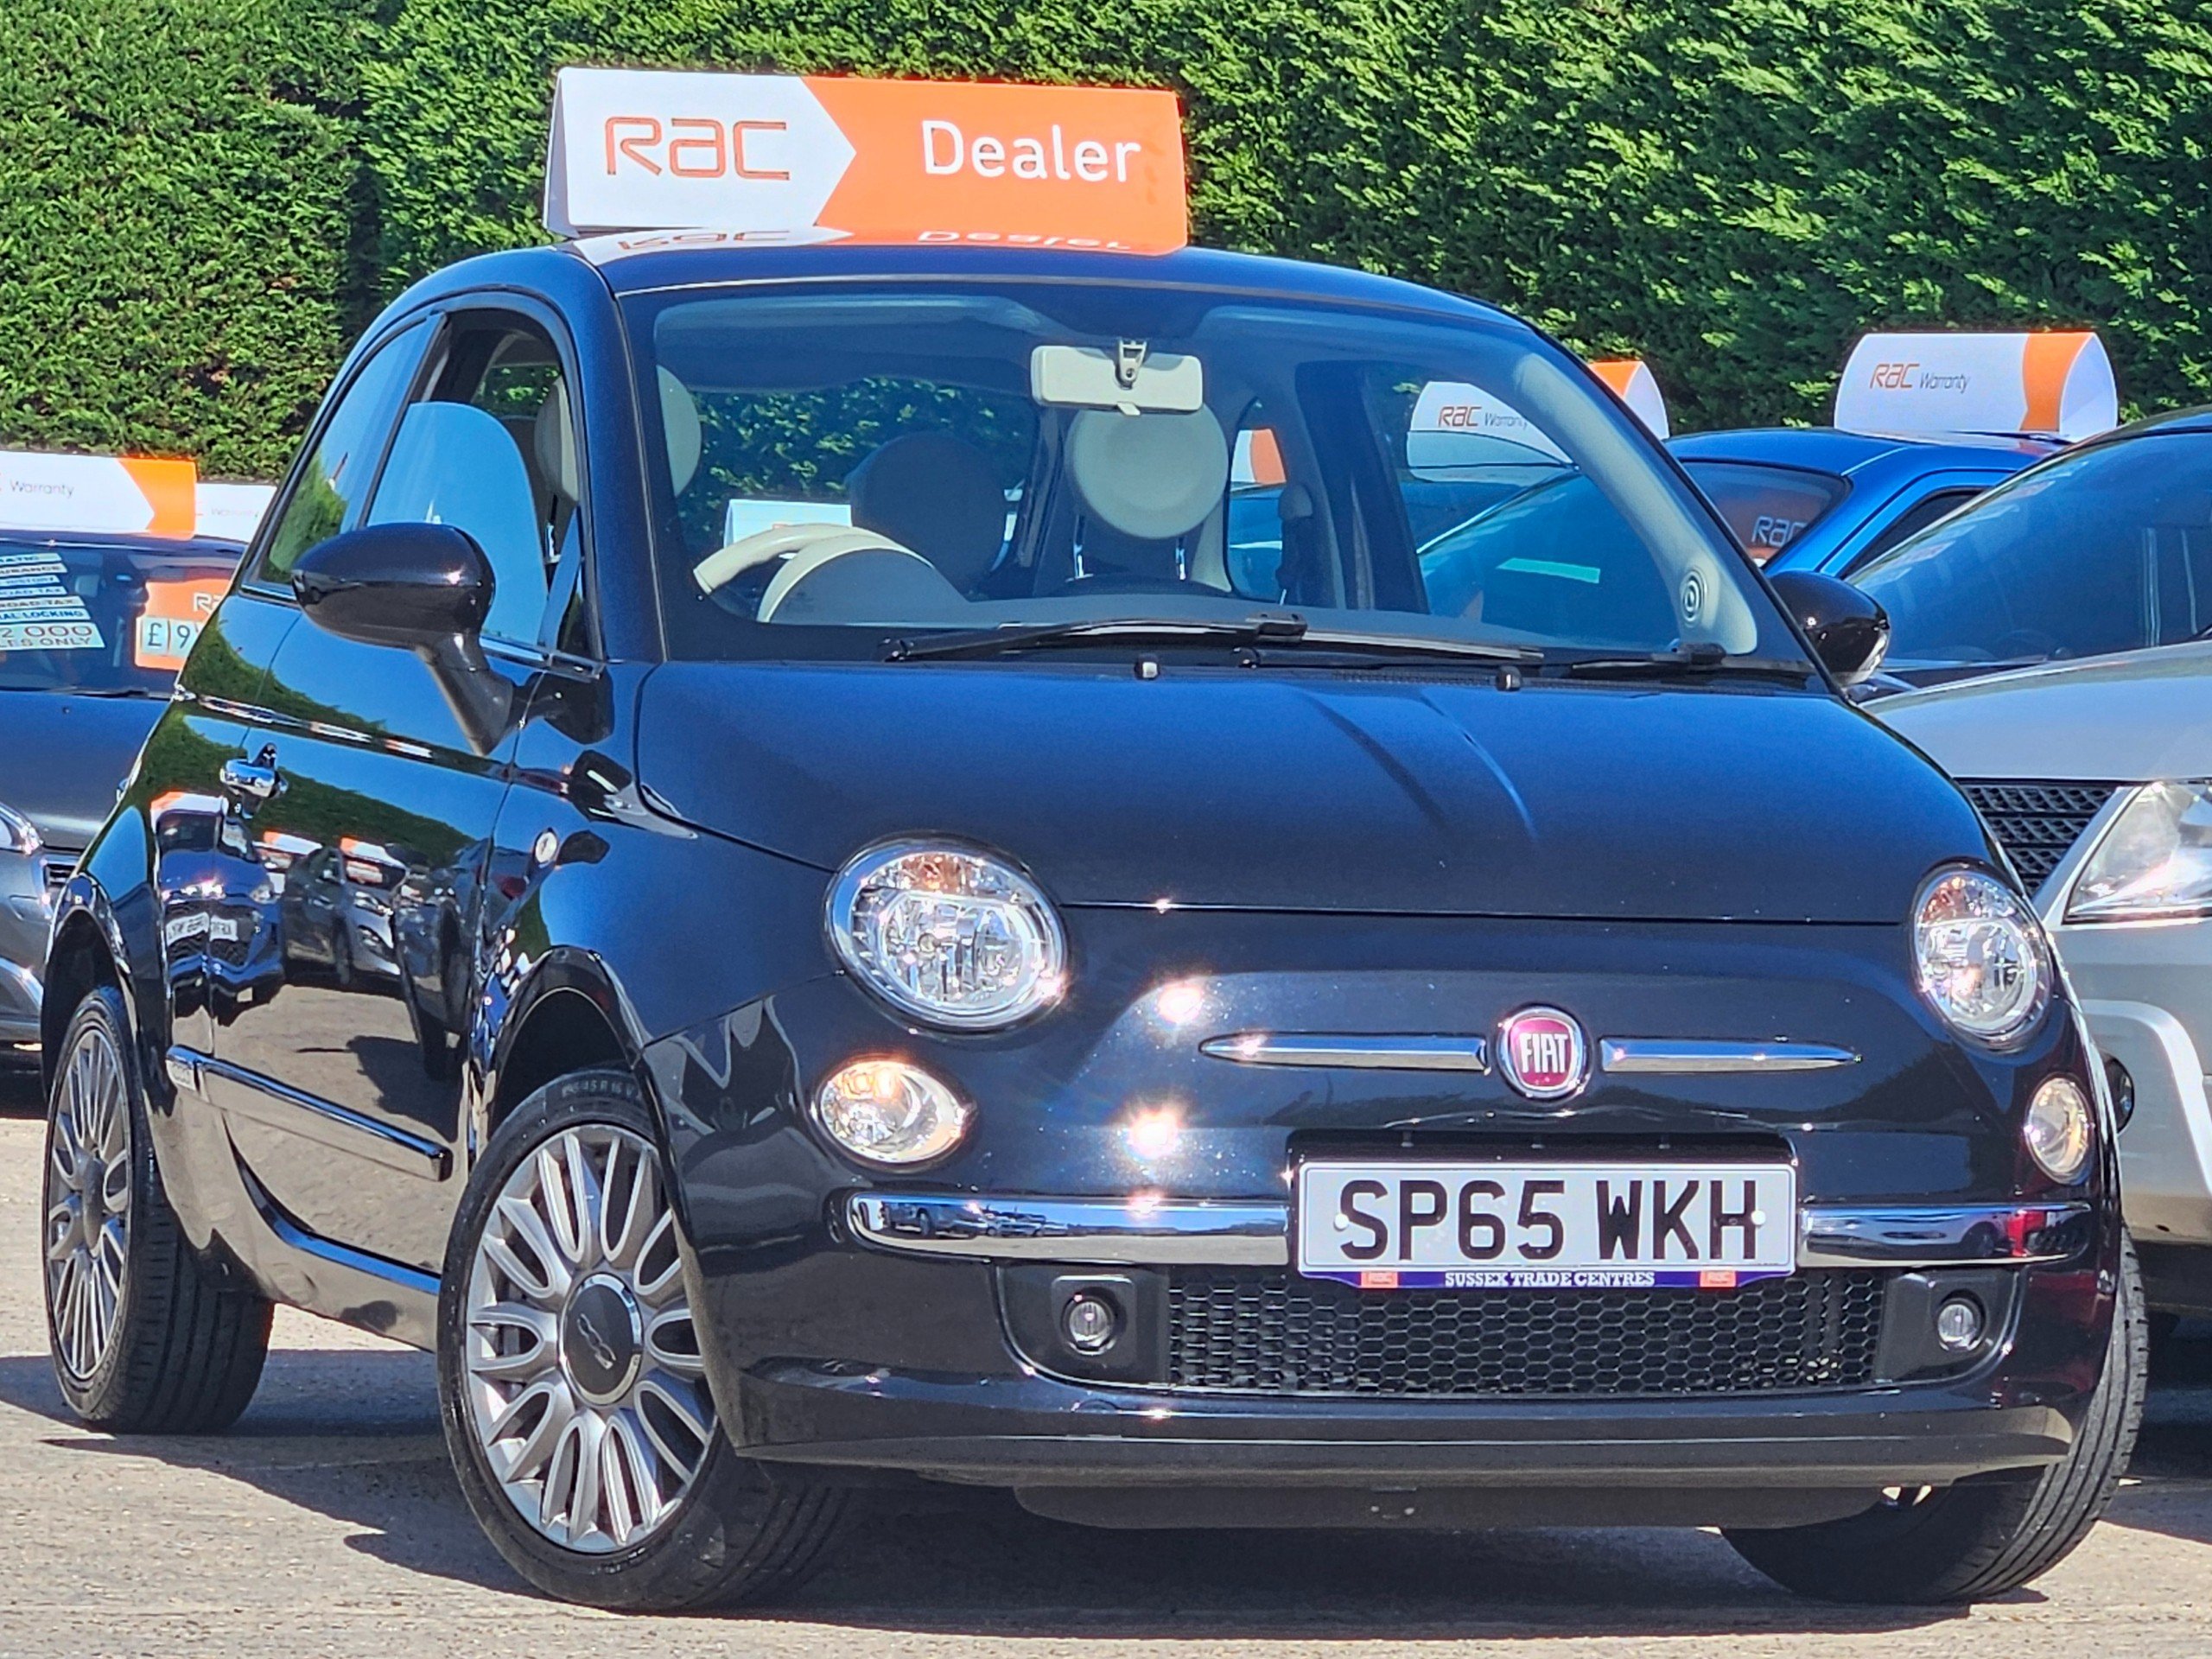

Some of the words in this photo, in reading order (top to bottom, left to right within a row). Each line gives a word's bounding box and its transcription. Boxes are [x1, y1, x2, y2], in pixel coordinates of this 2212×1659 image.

[921, 119, 1141, 182] Dealer
[1919, 372, 1971, 394] Warranty
[10, 480, 74, 499] Warranty
[39, 636, 91, 646] ONLY
[1519, 1033, 1568, 1073] FIAT
[1339, 1179, 1565, 1261] SP65
[1595, 1179, 1758, 1261] WKH
[1444, 1272, 1509, 1287] SUSSEX
[1510, 1272, 1573, 1287] TRADE
[1573, 1272, 1656, 1287] CENTRES
